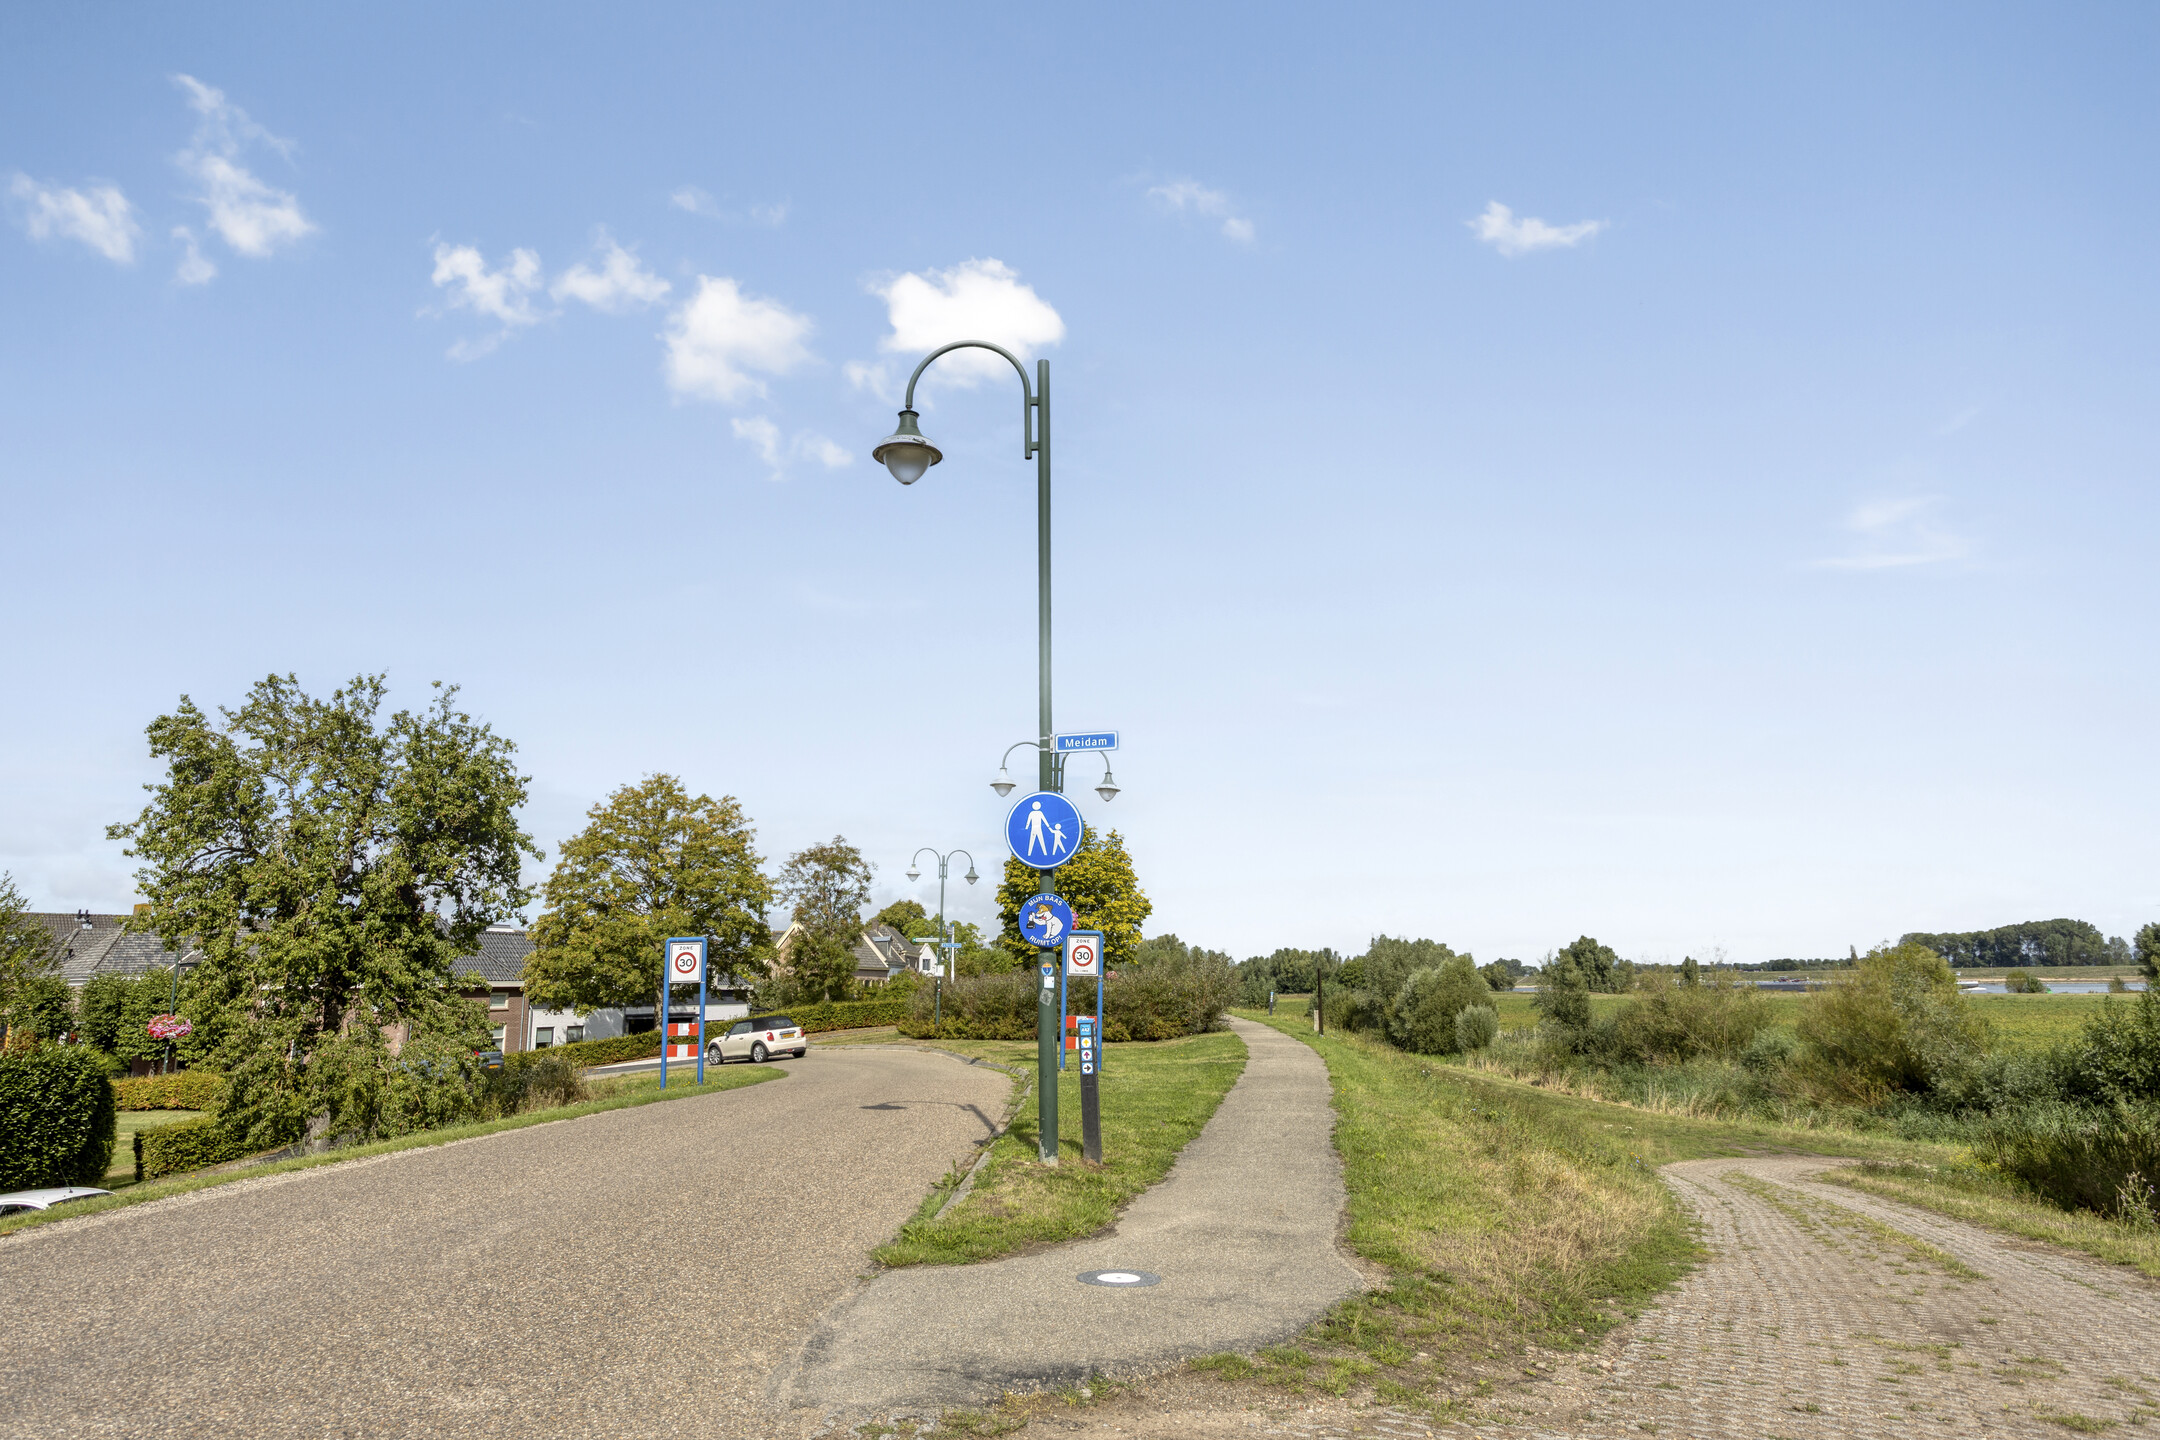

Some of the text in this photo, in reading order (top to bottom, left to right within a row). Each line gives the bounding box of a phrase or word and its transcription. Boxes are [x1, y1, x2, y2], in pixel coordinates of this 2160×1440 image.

[1065, 737, 1107, 748] Meidam
[1028, 895, 1063, 907] MIJN BAAS
[1029, 935, 1063, 946] RUIMT OP!
[1076, 951, 1090, 960] 30
[679, 958, 693, 967] 30
